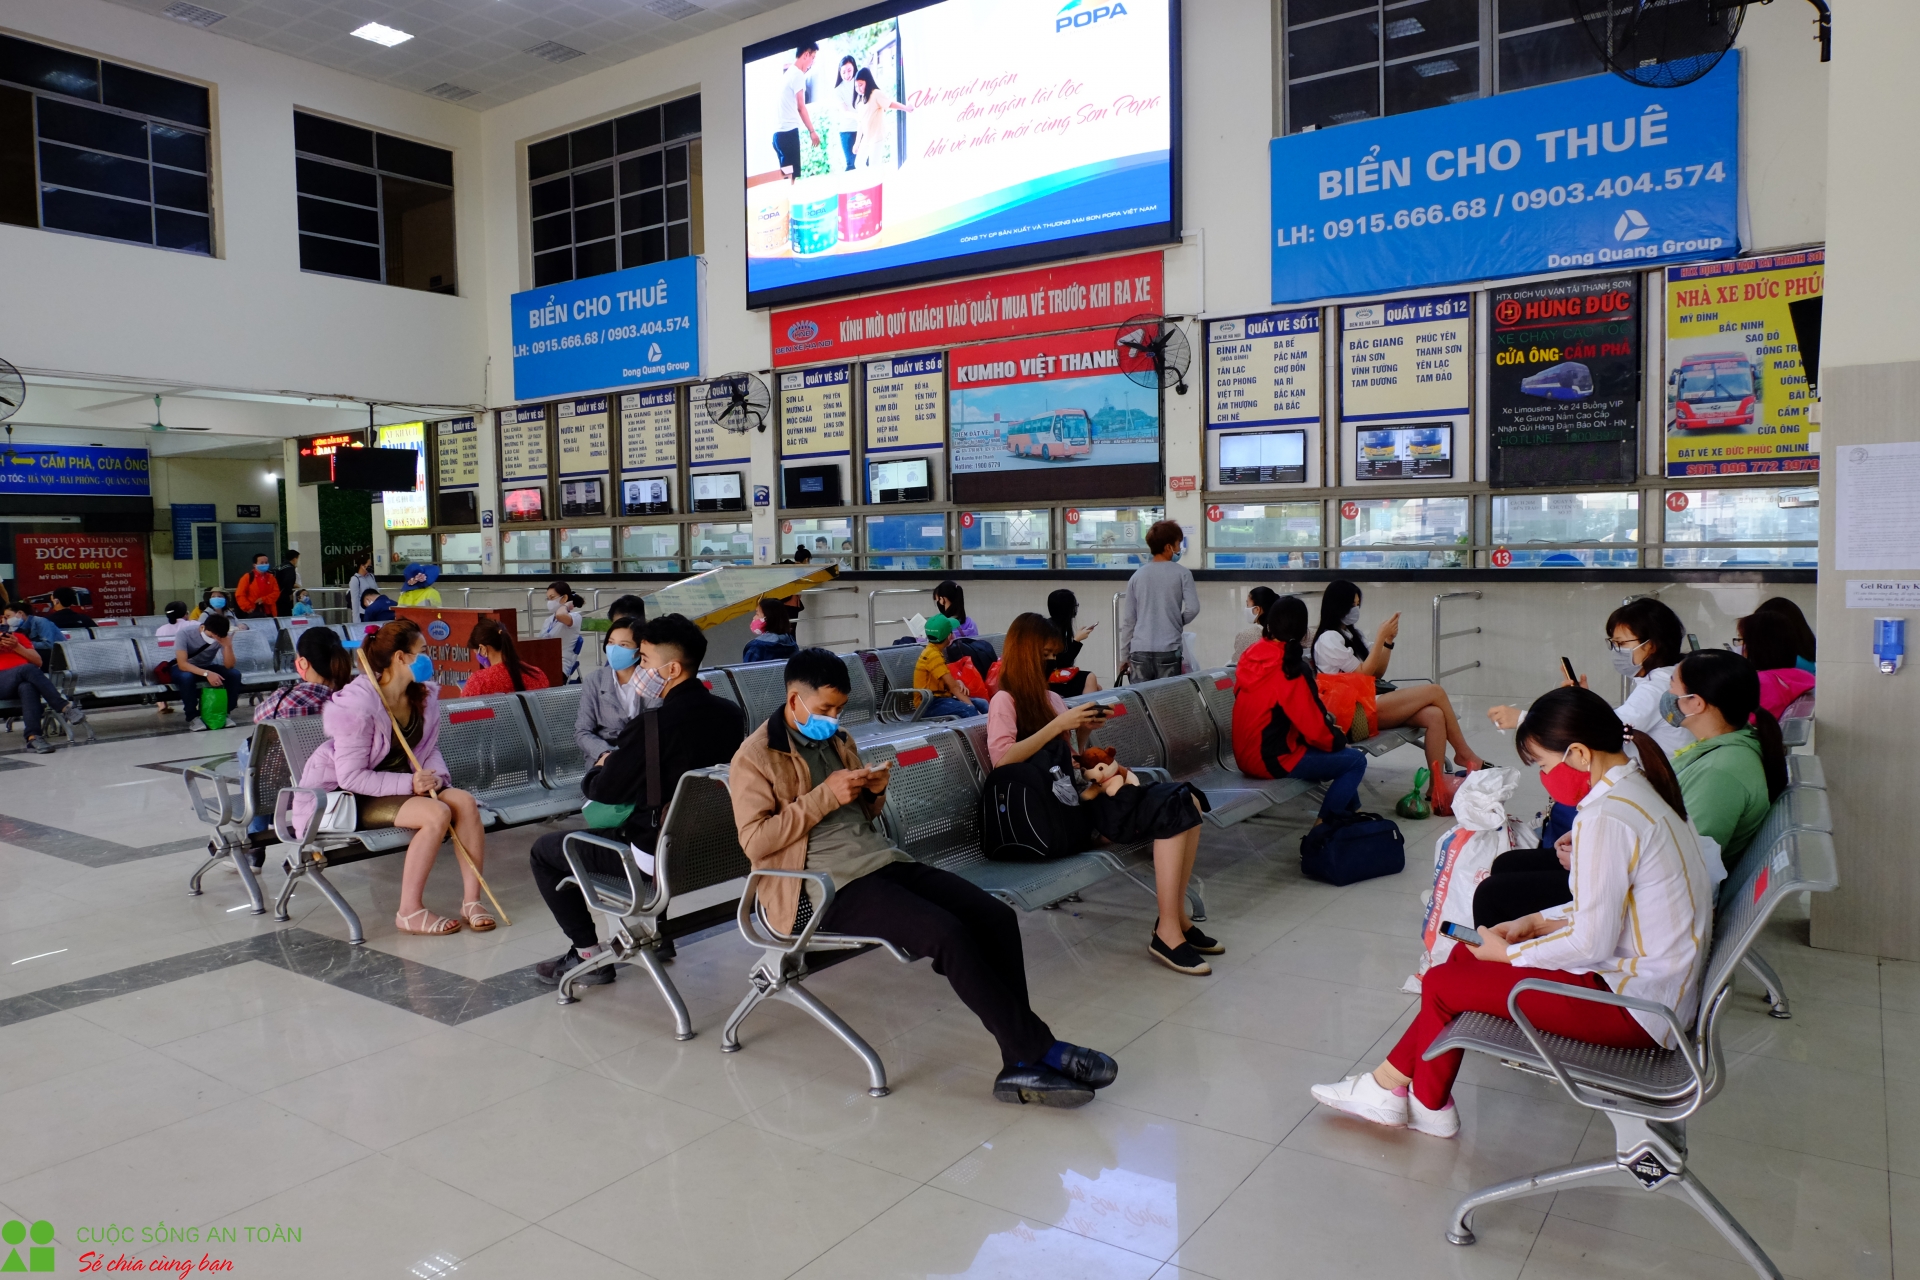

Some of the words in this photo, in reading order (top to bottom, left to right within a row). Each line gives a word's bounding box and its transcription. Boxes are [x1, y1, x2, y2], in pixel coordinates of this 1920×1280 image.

[1055, 3, 1127, 33] POPA
[908, 87, 942, 108] Vui
[1113, 95, 1161, 116] Popa
[1318, 144, 1411, 200] BIỂN
[1426, 138, 1521, 183] CHO
[1536, 104, 1669, 163] THUÊ
[1277, 225, 1316, 247] LH:
[1322, 197, 1486, 241] 0915.666.68
[1511, 161, 1726, 212] 0903.404.574
[1548, 251, 1594, 268] Dong
[1599, 242, 1658, 264] Quang
[1662, 235, 1722, 253] Group
[1676, 284, 1712, 308] NHÀ
[1716, 285, 1739, 304] XE
[1743, 277, 1780, 301] ĐỨC
[529, 295, 568, 329] BIỂN
[573, 296, 611, 320] CHO
[617, 279, 668, 312] THUÊ
[839, 316, 863, 342] KÍNH
[866, 311, 885, 338] MỜI
[887, 308, 907, 338] QUÝ
[909, 304, 944, 332] KHÁCH
[946, 300, 967, 327] VÀO
[970, 291, 999, 326] QUẦY
[1002, 294, 1028, 320] MUA
[1030, 286, 1045, 316] VÉ
[1048, 282, 1087, 313] TRƯỚC
[1090, 282, 1110, 308] KHI
[1114, 279, 1131, 305] RA
[1134, 276, 1150, 302] XE
[1525, 297, 1581, 320] HÙNG
[1585, 289, 1630, 314] ĐỨC
[1387, 304, 1416, 322] QUẦY
[1418, 305, 1433, 318] VÉ
[1435, 299, 1451, 315] SỐ
[1453, 300, 1467, 313] 12
[1680, 313, 1694, 324] MỸ
[1696, 311, 1718, 322] ĐÌNH
[1248, 319, 1275, 335] QUẦY
[1277, 317, 1290, 331] VÉ
[1740, 320, 1764, 332] NINH
[513, 343, 529, 357] LH:
[532, 331, 599, 355] 0915.666.68
[608, 316, 690, 341] 0903.404.574
[1372, 336, 1404, 348] GIANG
[1416, 332, 1438, 343] PHÚC
[1440, 331, 1456, 341] YÊN
[1745, 333, 1764, 343] SAO
[1216, 344, 1237, 355] BÌNH
[1240, 344, 1252, 353] AN
[1416, 347, 1443, 356] THANH
[1445, 344, 1462, 354] SƠN
[1352, 354, 1367, 363] TÂN
[1369, 352, 1385, 361] SƠN
[1496, 347, 1525, 365] CỬA
[623, 367, 641, 378] Dong
[643, 364, 665, 375] Quang
[667, 361, 690, 373] Group
[894, 361, 913, 375] QUẦY
[914, 360, 924, 371] VÉ
[925, 357, 936, 370] SỐ
[937, 359, 942, 369] 8
[957, 361, 1016, 383] KUMHO
[1019, 353, 1058, 378] VIỆT
[1059, 349, 1119, 371] THANH
[1233, 365, 1246, 375] LẠC
[1351, 366, 1370, 375] VĨNH
[1372, 363, 1398, 374] TƯỜNG
[1416, 360, 1431, 370] YÊN
[1434, 359, 1450, 370] LẠC
[1773, 360, 1796, 371] MẠO
[1217, 378, 1231, 387] CAO
[1233, 377, 1257, 386] PHONG
[1274, 378, 1284, 386] NA
[1352, 379, 1368, 387] TAM
[1370, 376, 1397, 387] DƯƠNG
[1416, 374, 1433, 383] TAM
[1217, 389, 1232, 399] VIỆT
[875, 404, 886, 412] KIM
[1780, 424, 1800, 434] ÔNG
[1697, 446, 1709, 457] VÉ
[1711, 447, 1723, 456] XE
[1725, 445, 1744, 456] ĐỨC
[1747, 444, 1773, 454] PHÚC
[1776, 443, 1810, 454] ONLINE
[1687, 463, 1717, 475] SĐT:
[1720, 461, 1747, 474] 096
[1750, 460, 1779, 473] 772
[1782, 459, 1820, 471] 3979
[1670, 497, 1686, 507] 14
[1067, 511, 1079, 523] 10
[1209, 509, 1221, 519] 11
[1343, 506, 1357, 516] 12
[963, 514, 971, 526] 9
[35, 546, 75, 560] ĐỨC
[79, 545, 128, 559] PHÚC
[1495, 553, 1510, 564] 13
[57, 563, 77, 571] CHẠY
[79, 560, 100, 570] QUỐC
[101, 560, 111, 570] LỘ
[1895, 583, 1911, 591] Tay
[428, 645, 437, 660] XE
[452, 644, 470, 662] ĐÌNH
